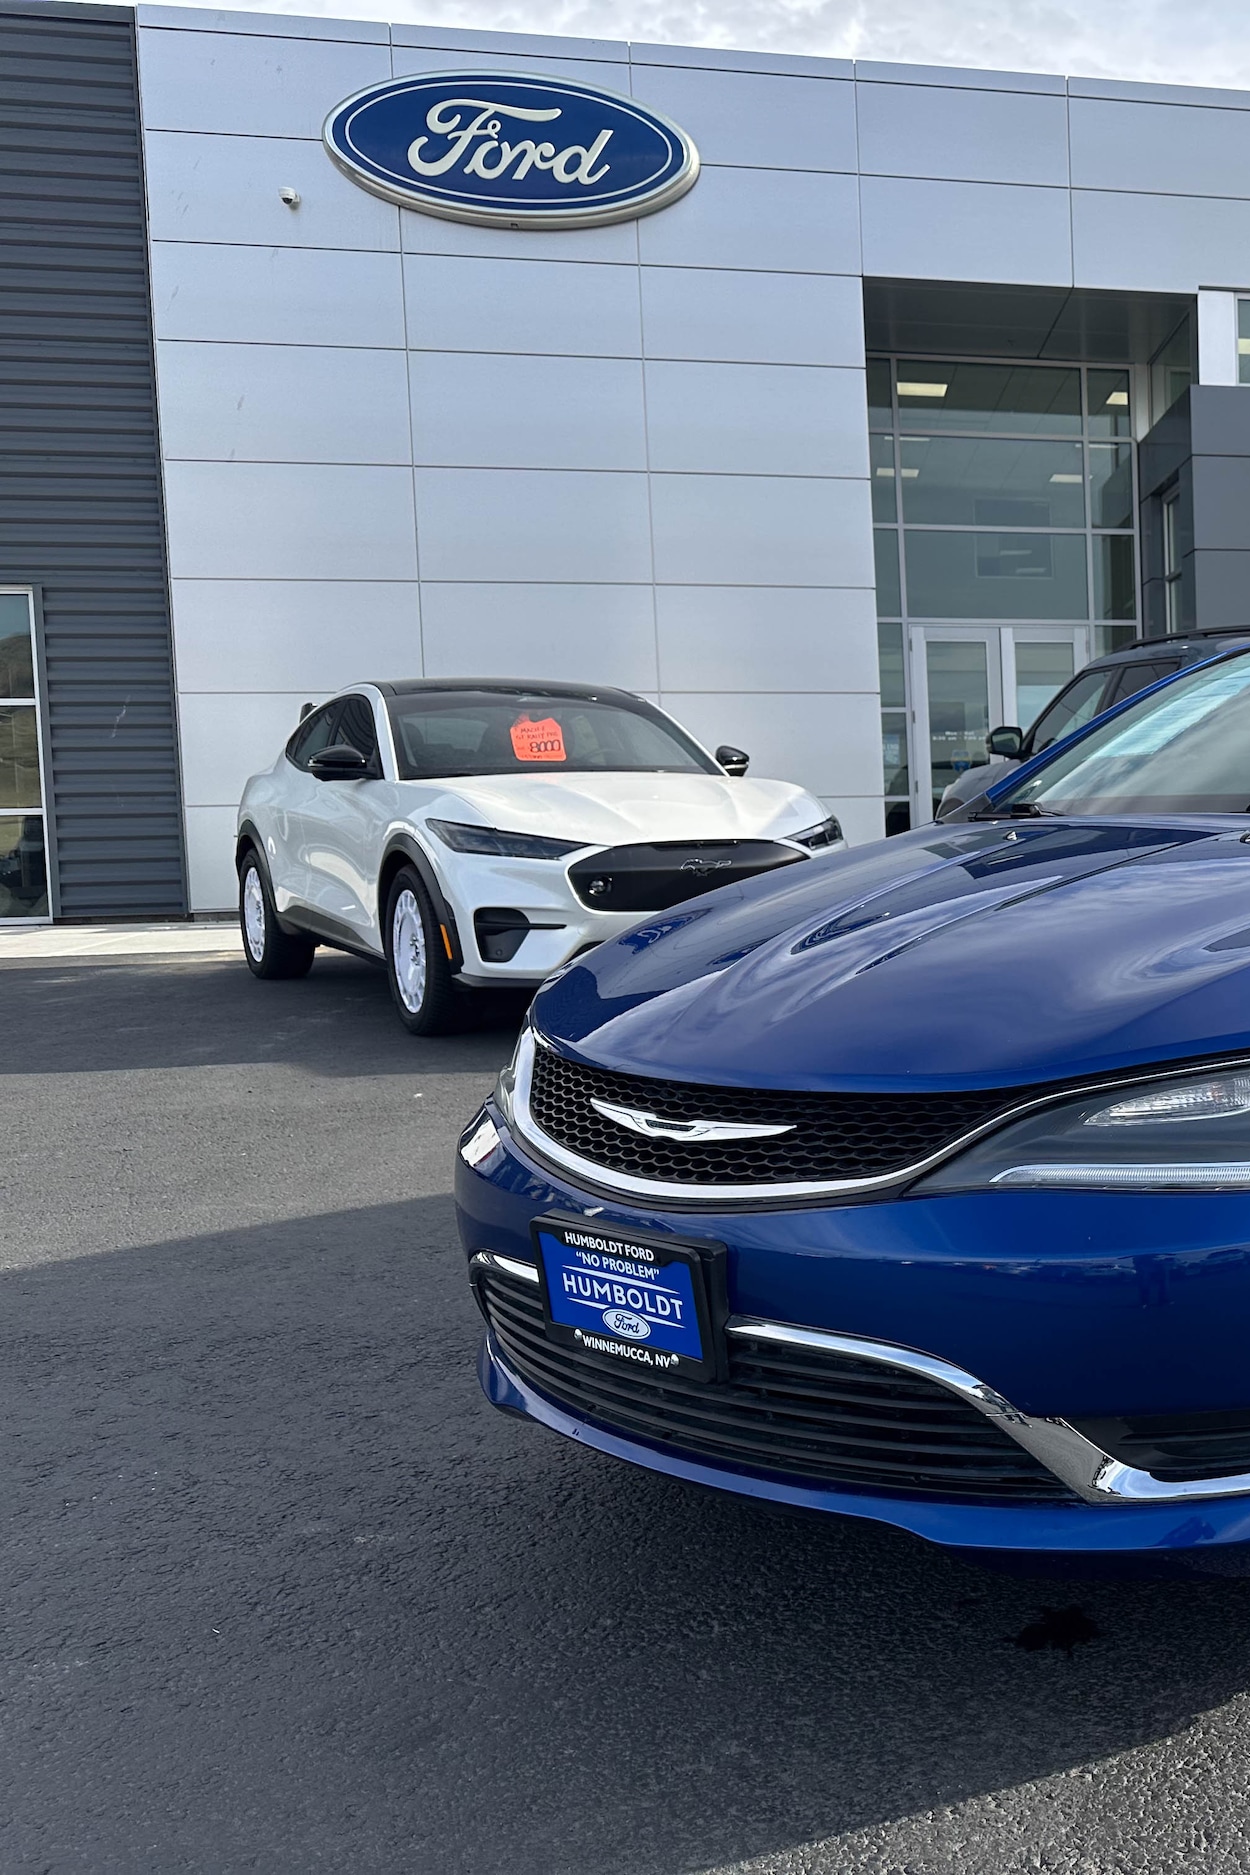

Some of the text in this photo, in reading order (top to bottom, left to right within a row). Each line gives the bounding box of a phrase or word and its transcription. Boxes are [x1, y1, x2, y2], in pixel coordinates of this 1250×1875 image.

[407, 98, 614, 186] Ford
[564, 1231, 655, 1262] HUMBOLDT FORD
[562, 1272, 683, 1320] HUMBOLDT
[613, 1313, 640, 1334] Ford
[582, 1334, 671, 1369] WINNEMUCCA, NV
